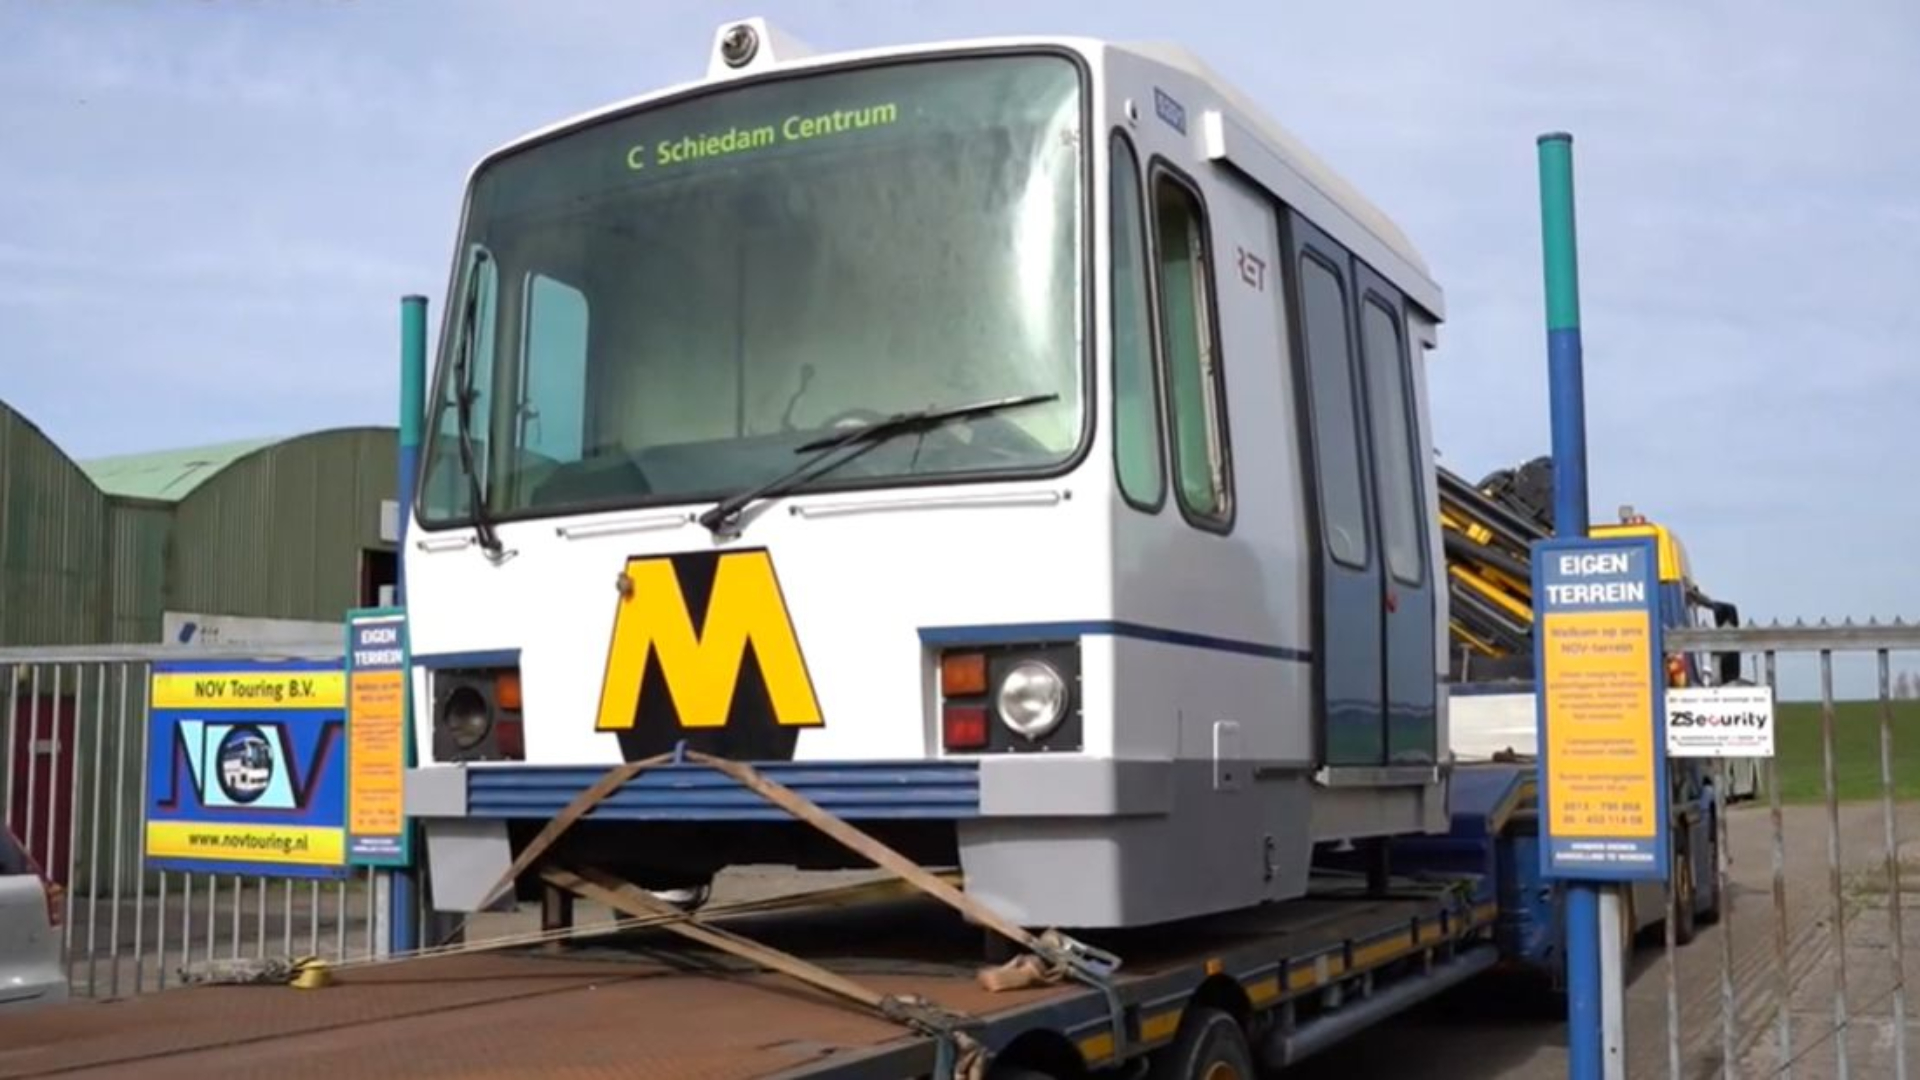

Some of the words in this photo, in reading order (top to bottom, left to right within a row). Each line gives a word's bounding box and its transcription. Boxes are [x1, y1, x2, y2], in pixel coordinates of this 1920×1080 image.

[627, 145, 645, 169] C
[657, 125, 775, 165] Schiedam
[782, 102, 897, 140] Centrum
[1560, 553, 1629, 575] EIGEN
[1545, 581, 1645, 605] TERREIN
[361, 627, 397, 645] EIGEN
[596, 548, 825, 731] M
[354, 648, 403, 666] TERREIN
[195, 679, 226, 698] NOV
[230, 679, 284, 702] Touring
[289, 679, 317, 698] B.V.
[188, 833, 309, 855] www.novtouring.nl
